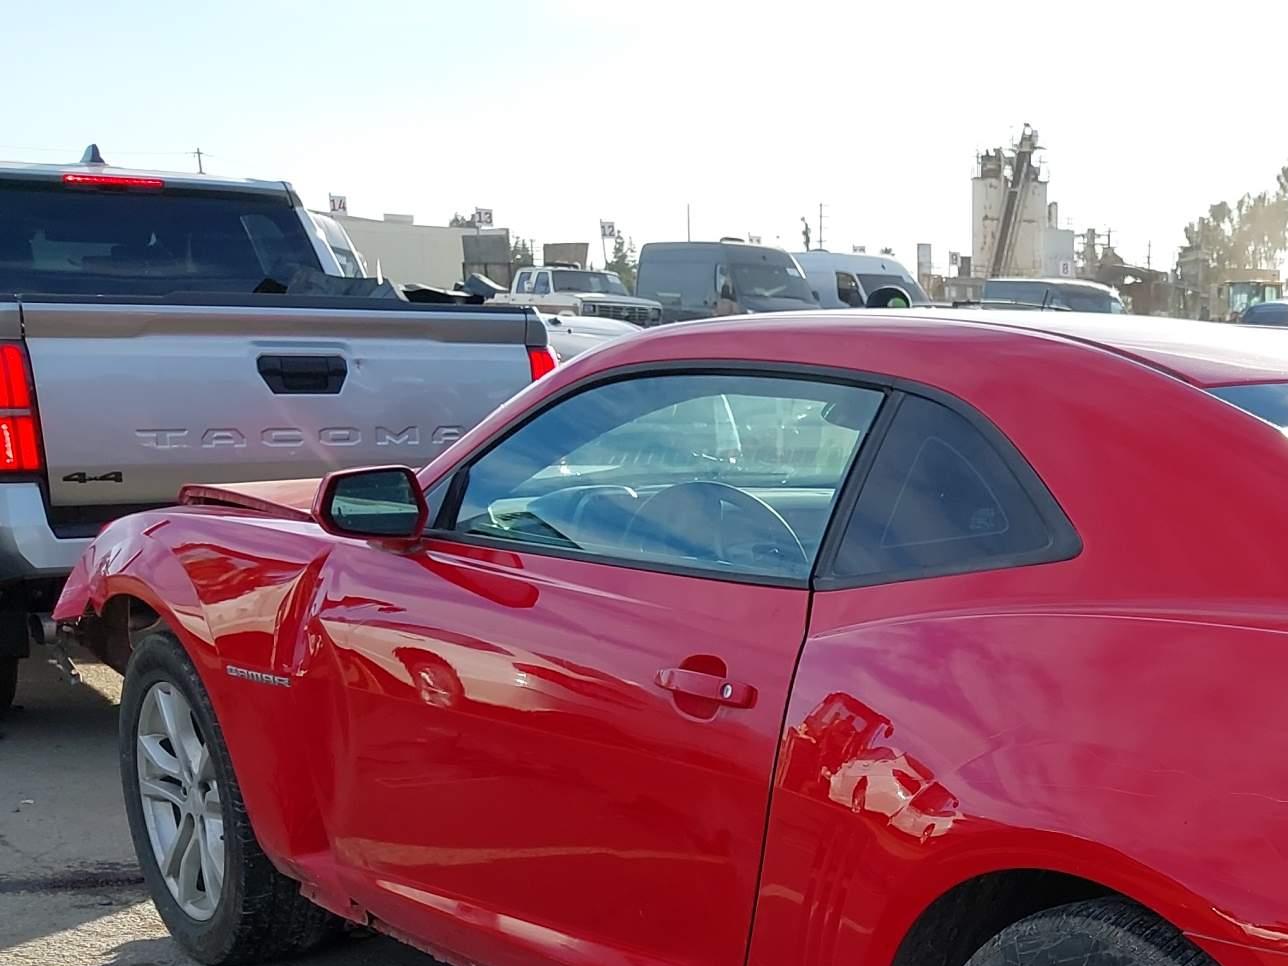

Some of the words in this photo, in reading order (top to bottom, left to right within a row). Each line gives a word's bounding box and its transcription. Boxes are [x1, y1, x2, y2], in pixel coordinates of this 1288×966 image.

[330, 198, 346, 212] 14
[476, 211, 493, 224] 13
[601, 225, 615, 237] 12
[135, 425, 464, 449] TACOMA
